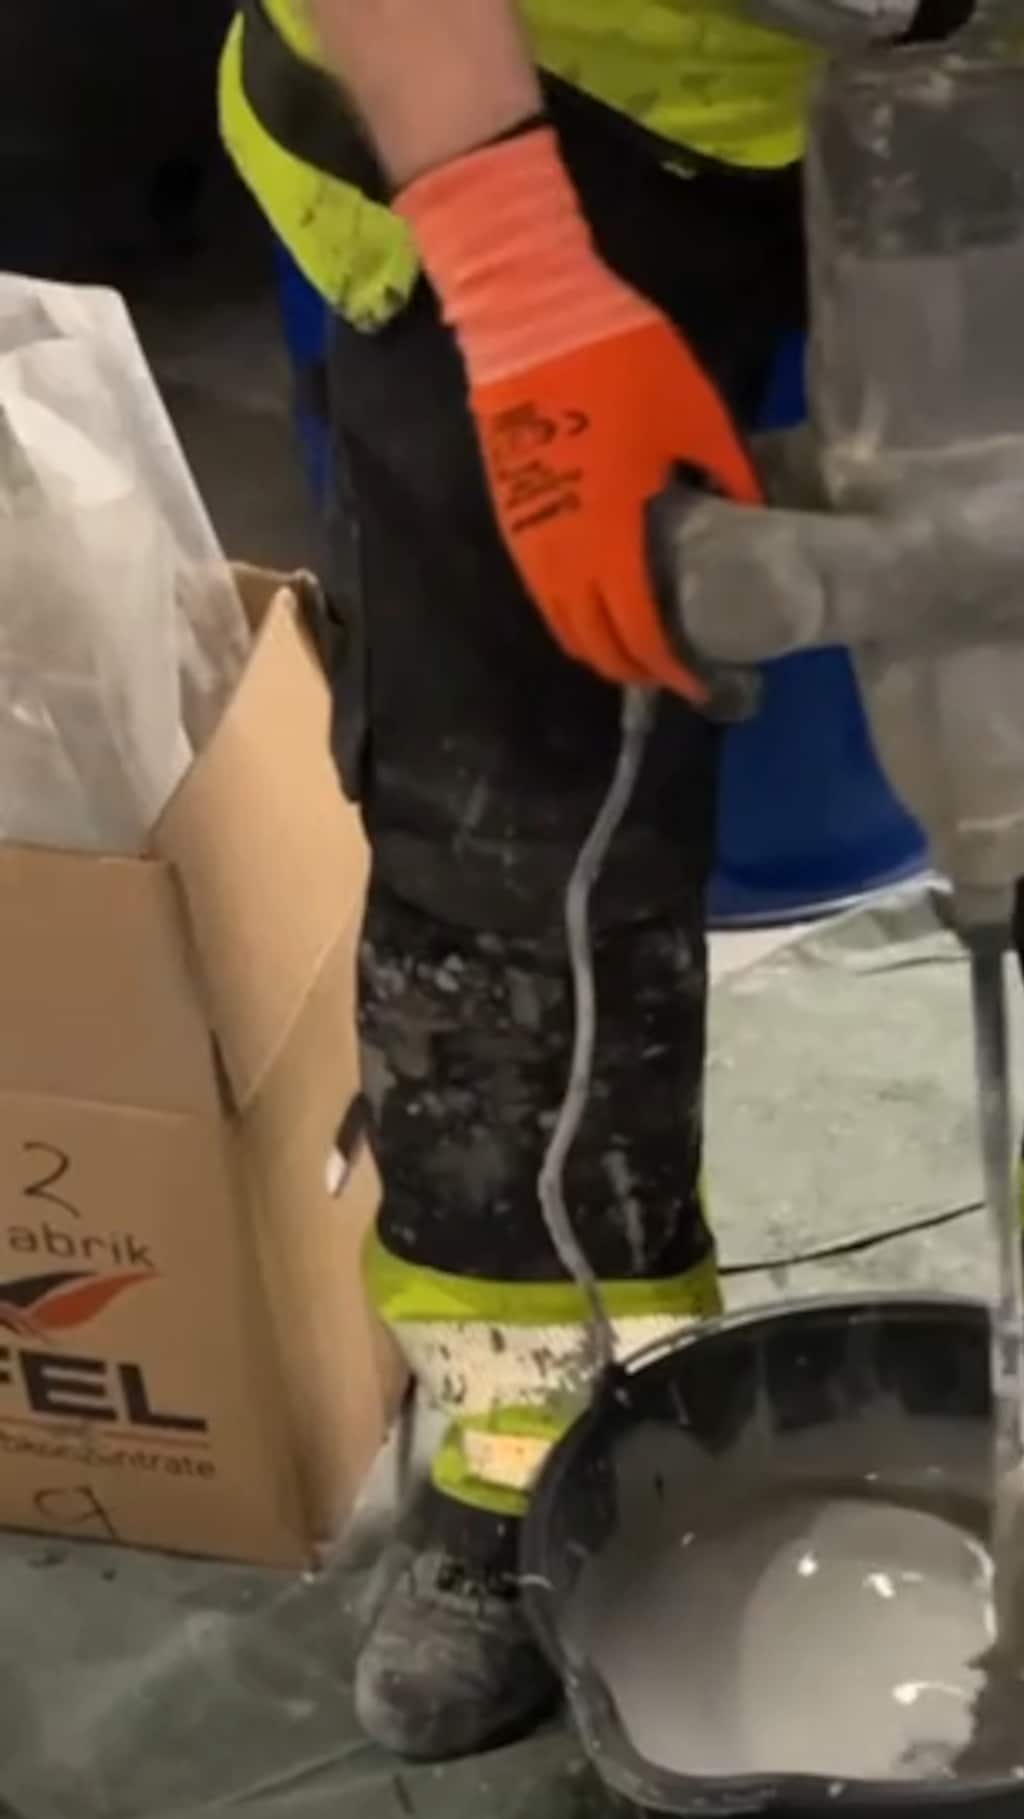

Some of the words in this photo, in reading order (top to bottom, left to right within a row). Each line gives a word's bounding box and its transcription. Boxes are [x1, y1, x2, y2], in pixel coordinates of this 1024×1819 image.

[23, 1141, 80, 1219] 2
[7, 1221, 156, 1268] abrik
[0, 1346, 208, 1433] EL
